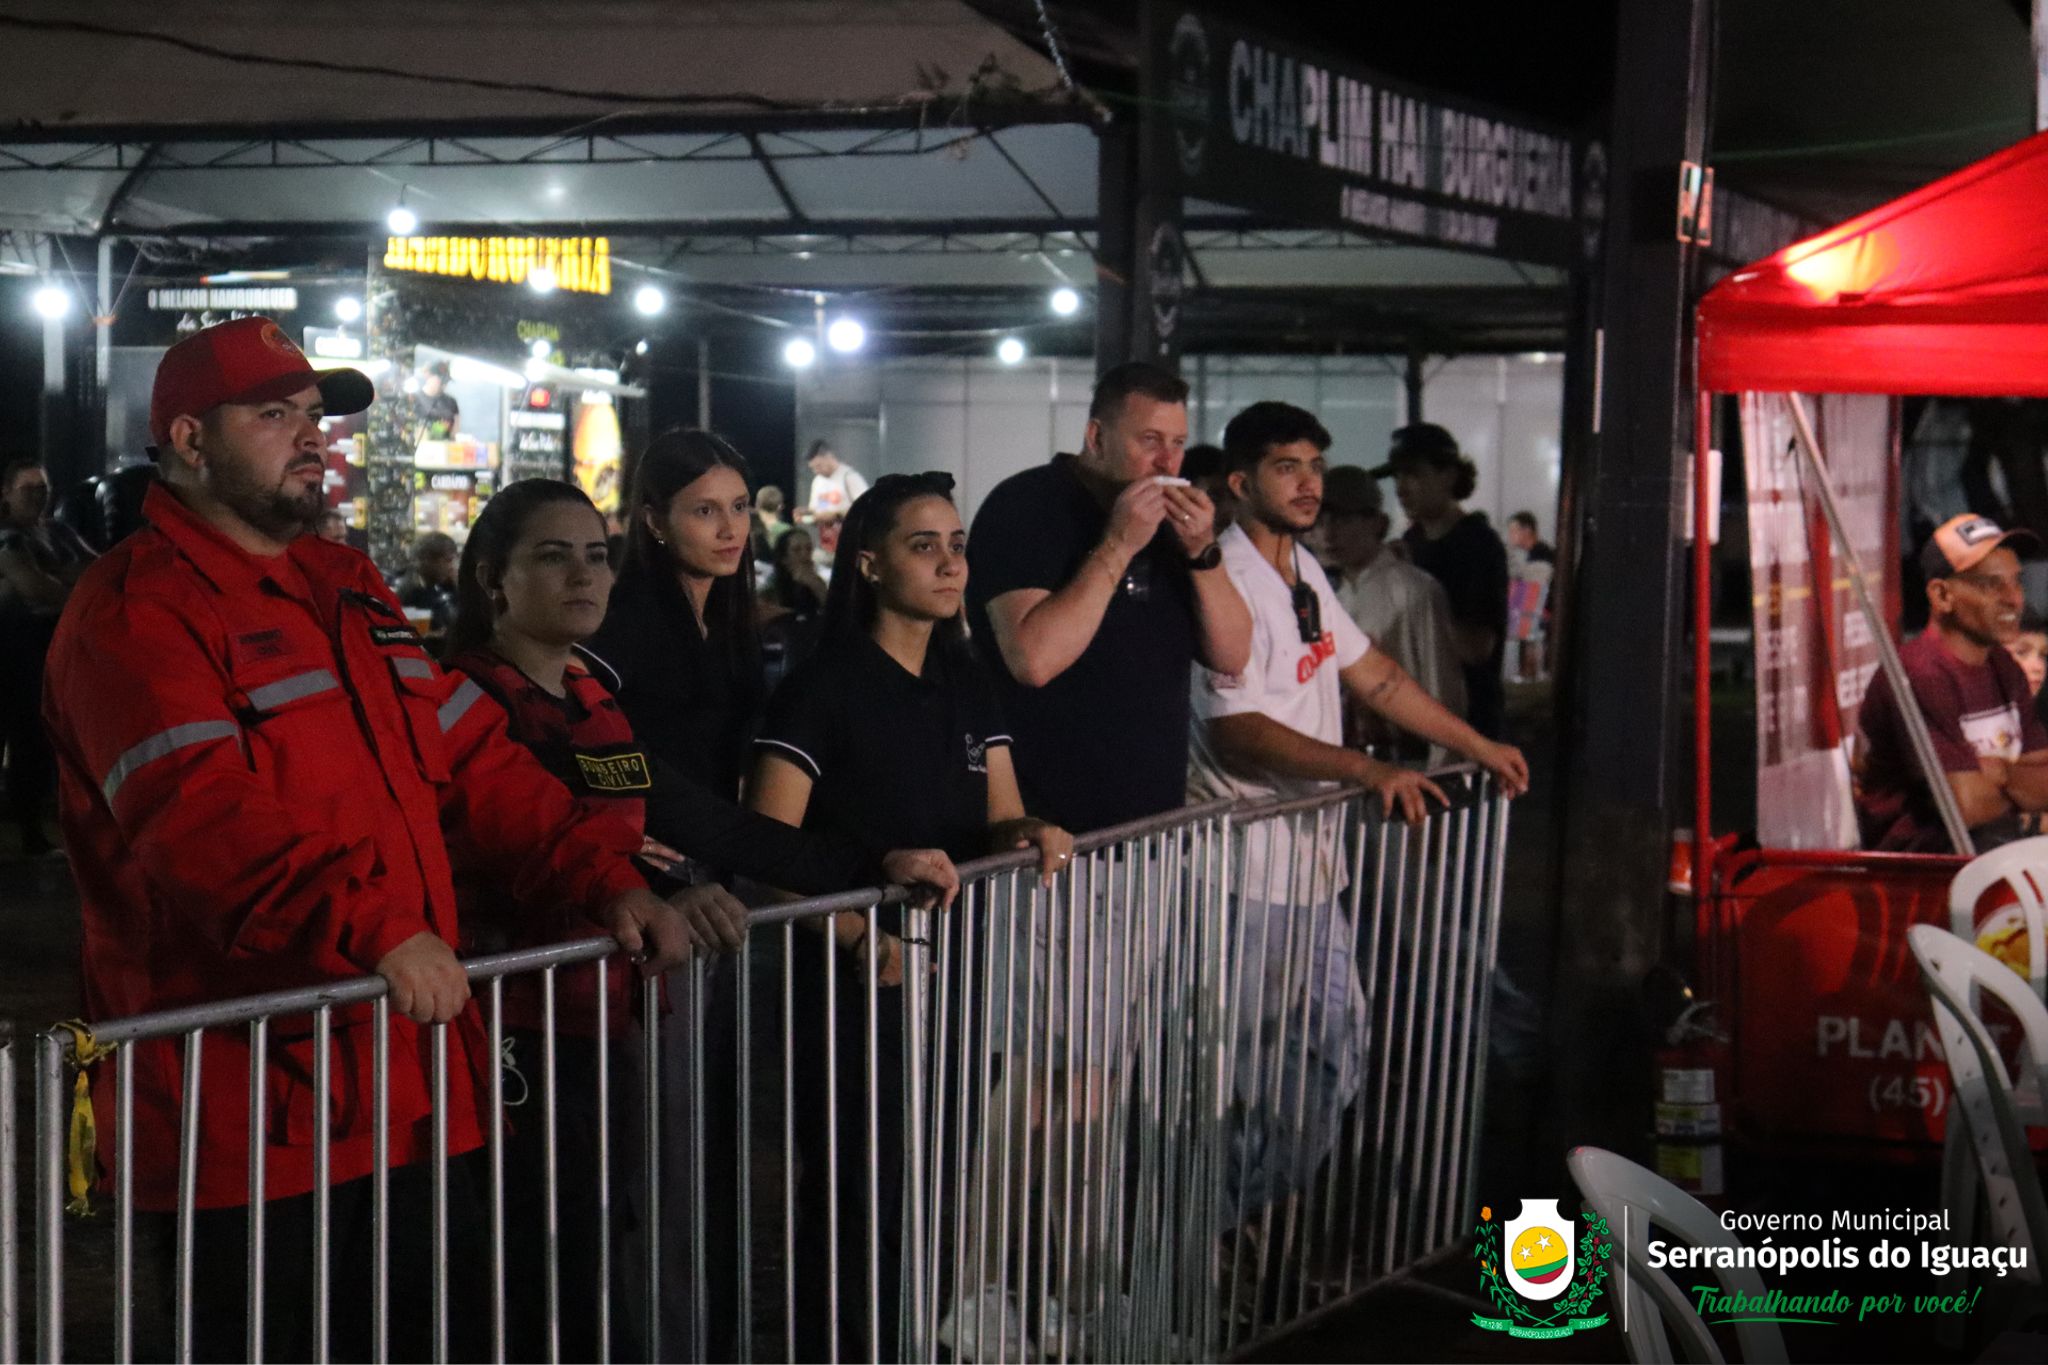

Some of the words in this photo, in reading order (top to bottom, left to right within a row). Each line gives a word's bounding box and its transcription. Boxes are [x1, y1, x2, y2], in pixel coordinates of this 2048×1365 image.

[1378, 89, 1573, 219] HABURGUERIA
[159, 288, 207, 310] MELHOR
[580, 758, 640, 774] BOMBEIRO
[598, 773, 631, 786] CIVIL
[1868, 1074, 1946, 1118] (45)
